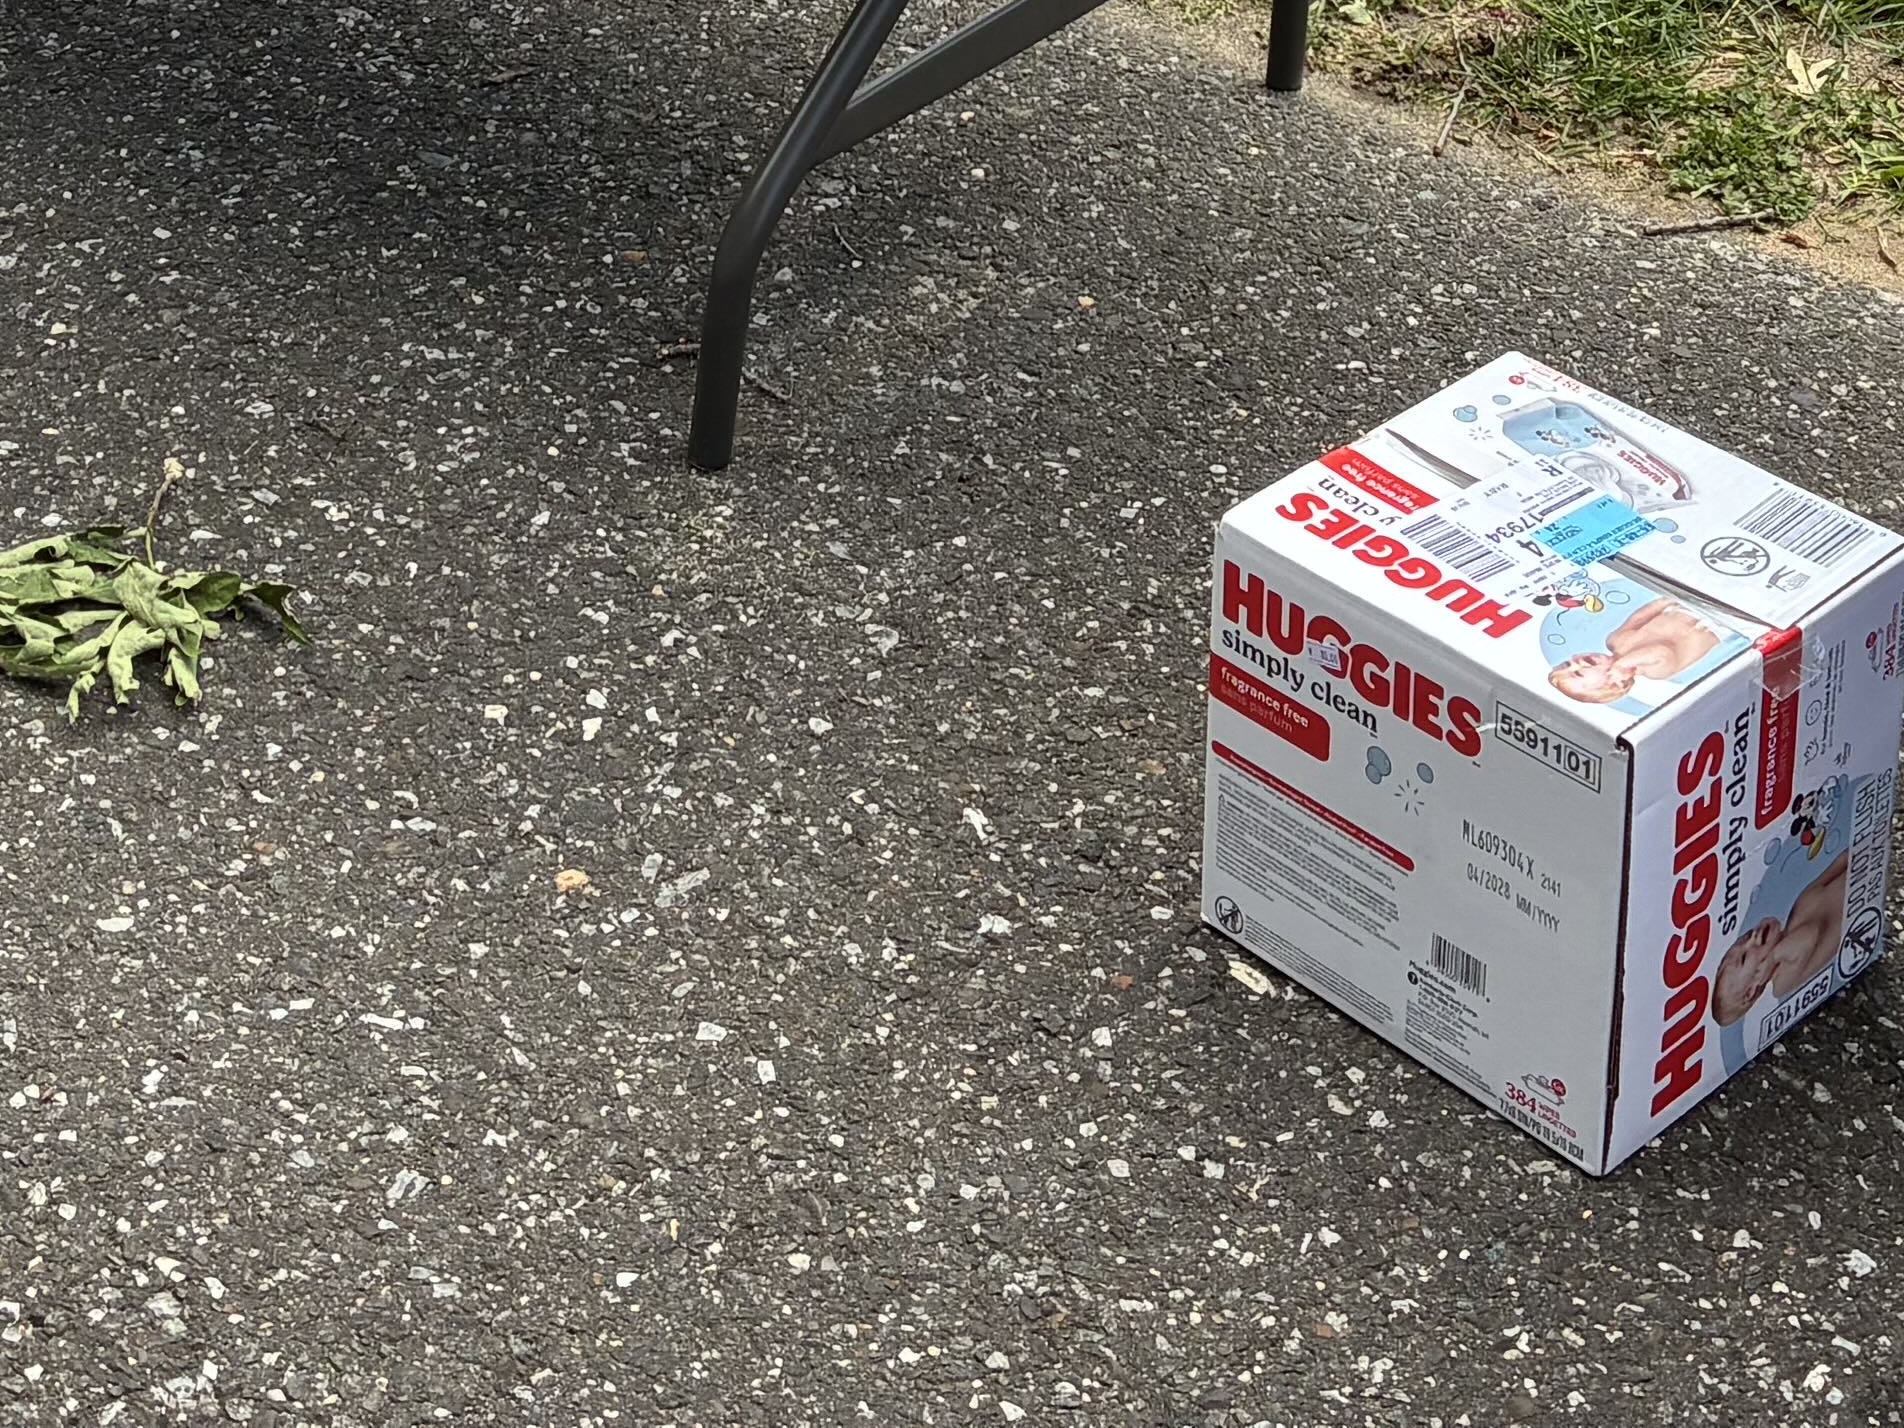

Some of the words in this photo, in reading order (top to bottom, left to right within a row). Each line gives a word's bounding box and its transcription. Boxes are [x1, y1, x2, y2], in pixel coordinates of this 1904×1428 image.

[1318, 476, 1380, 518] clean
[1485, 510, 1545, 545] 17934
[1516, 538, 1545, 558] 4
[1275, 491, 1533, 639] HUGGIES
[1222, 559, 1483, 758] HUGGIES
[1222, 628, 1306, 694] simply
[1310, 682, 1379, 736] clean
[1220, 665, 1283, 711] fragrance
[1283, 703, 1310, 730] free
[1249, 693, 1295, 735] parfum
[1729, 706, 1752, 811] clean
[1760, 720, 1778, 816] fragrance
[1854, 778, 1876, 838] FLUSH
[1467, 862, 1512, 901] 04/2028
[1722, 815, 1748, 937] simply
[1850, 842, 1871, 890] NOT
[1871, 846, 1887, 879] AUX
[1846, 892, 1866, 924] DO
[1867, 880, 1883, 906] PAS
[1650, 730, 1725, 1117] HUGGIES
[1504, 1081, 1537, 1114] 384
